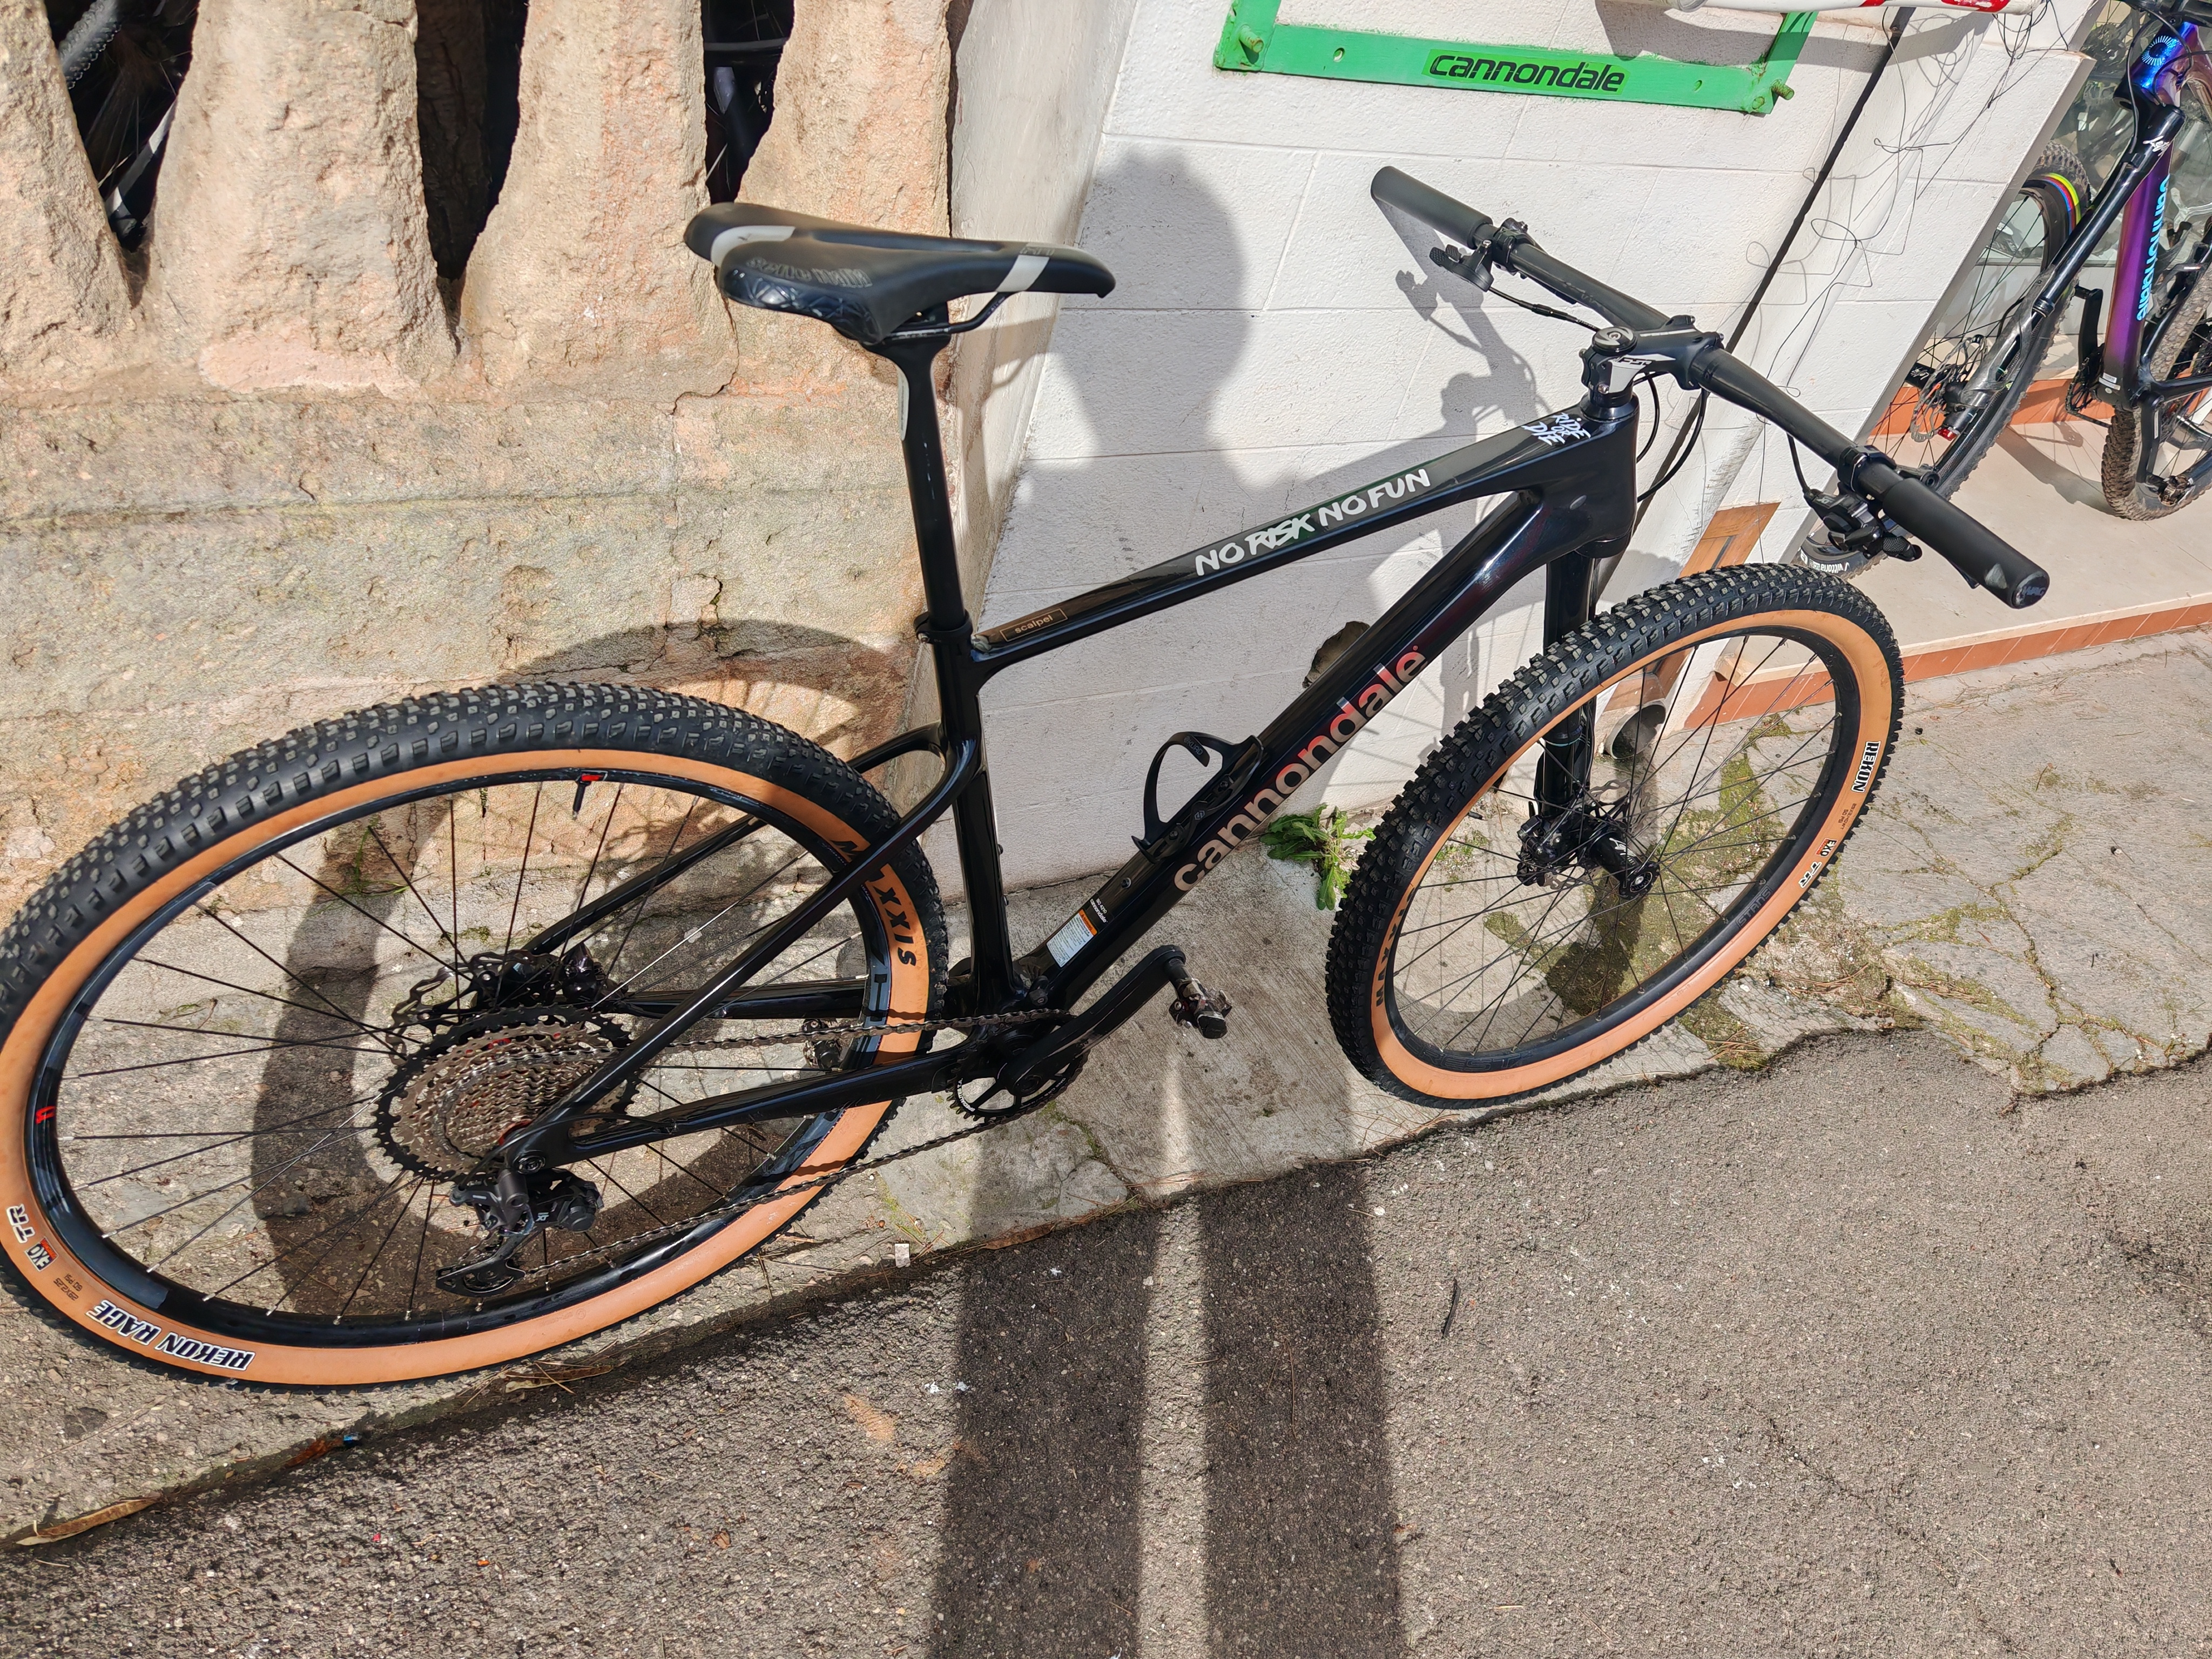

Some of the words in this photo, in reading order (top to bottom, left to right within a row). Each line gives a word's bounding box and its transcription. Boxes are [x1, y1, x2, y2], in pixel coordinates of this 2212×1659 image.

[1429, 54, 1625, 92] cannondale
[1195, 542, 1245, 576] NO
[1244, 512, 1316, 556] RISK
[1318, 495, 1367, 527] NO
[1367, 468, 1431, 509] FUN
[1014, 615, 1054, 635] scalpel
[1174, 650, 1429, 892] cannondale
[1851, 740, 1882, 793] REKON
[1798, 861, 1823, 888] TR
[1738, 888, 1771, 927] STANS
[6, 1203, 35, 1243] TR
[26, 1242, 53, 1269] EXO
[85, 1299, 162, 1346] RACE
[154, 1331, 256, 1371] REKON
